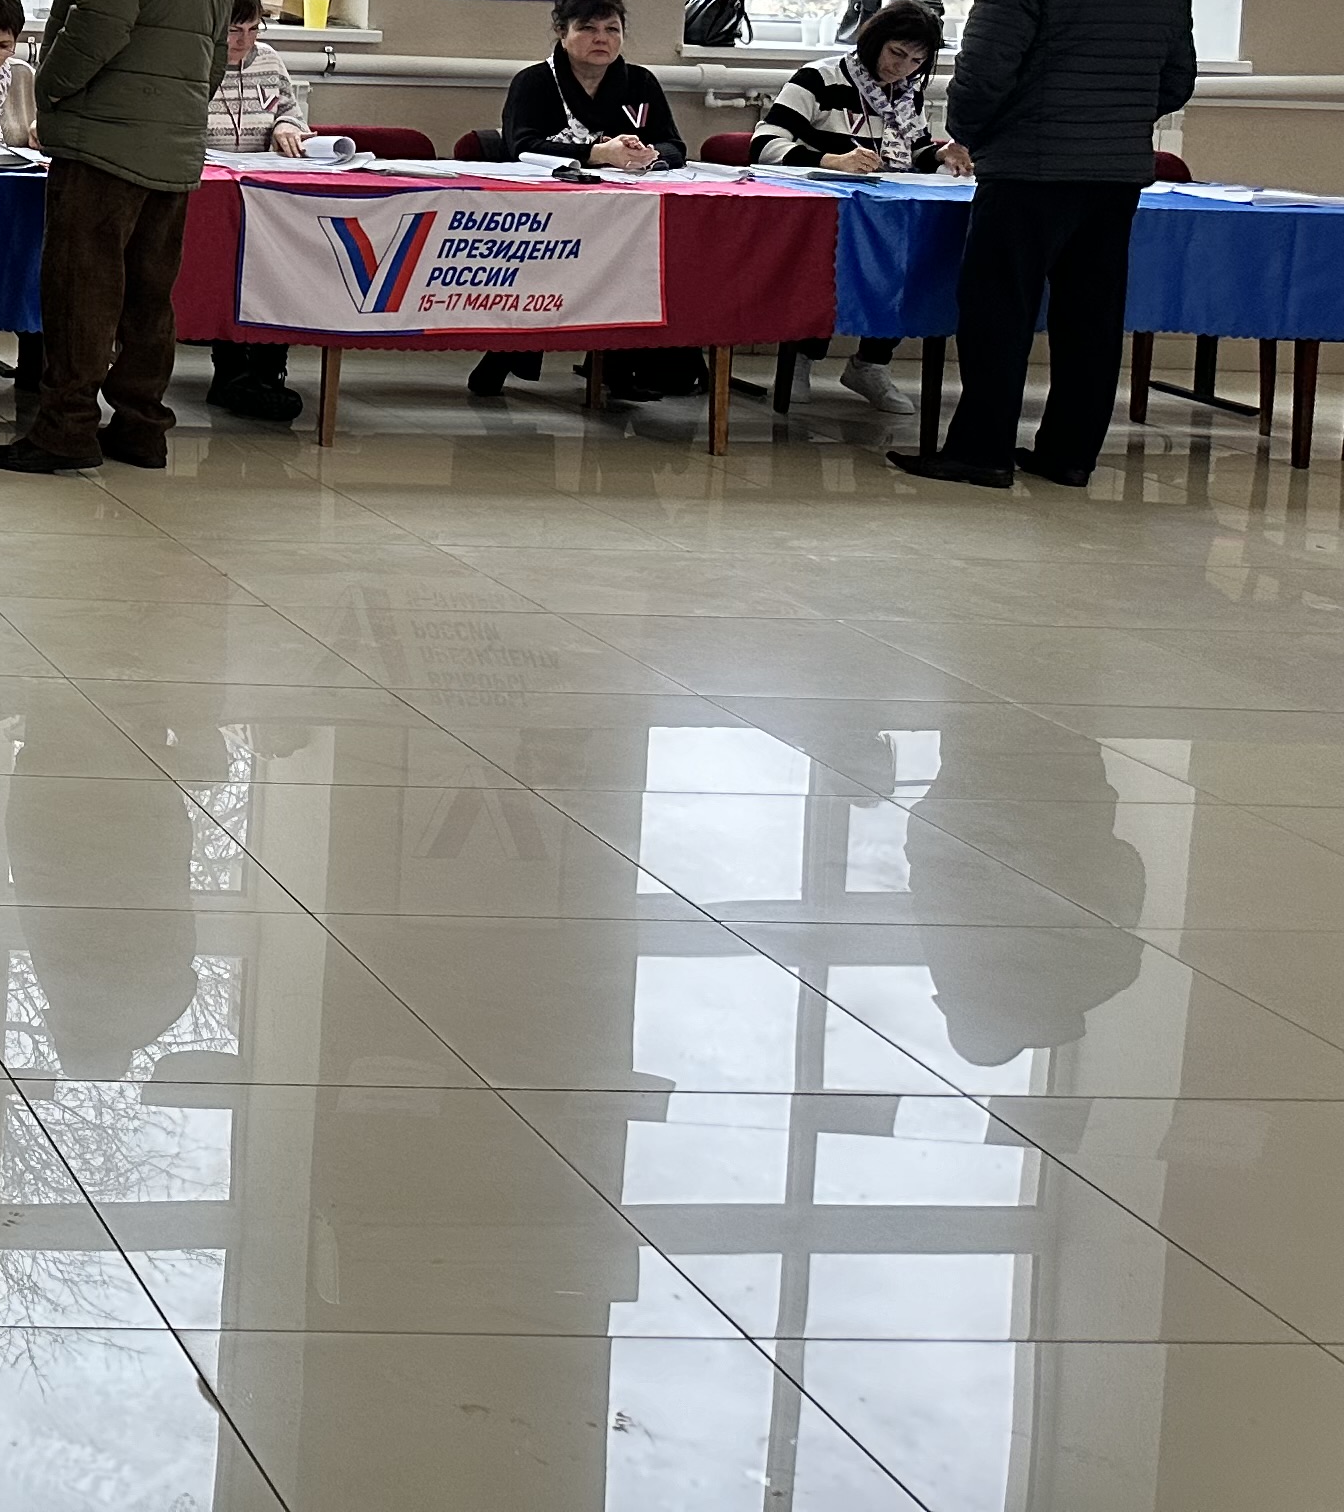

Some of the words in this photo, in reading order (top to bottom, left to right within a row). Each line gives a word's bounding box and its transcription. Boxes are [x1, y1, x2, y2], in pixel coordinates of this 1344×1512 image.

[447, 210, 553, 233] ВЫБОРЫ
[437, 238, 582, 263] ПРЕЗИДЕНТА
[425, 266, 520, 288] РОССИИ
[463, 293, 520, 312] МАРТА
[522, 293, 564, 312] 2024
